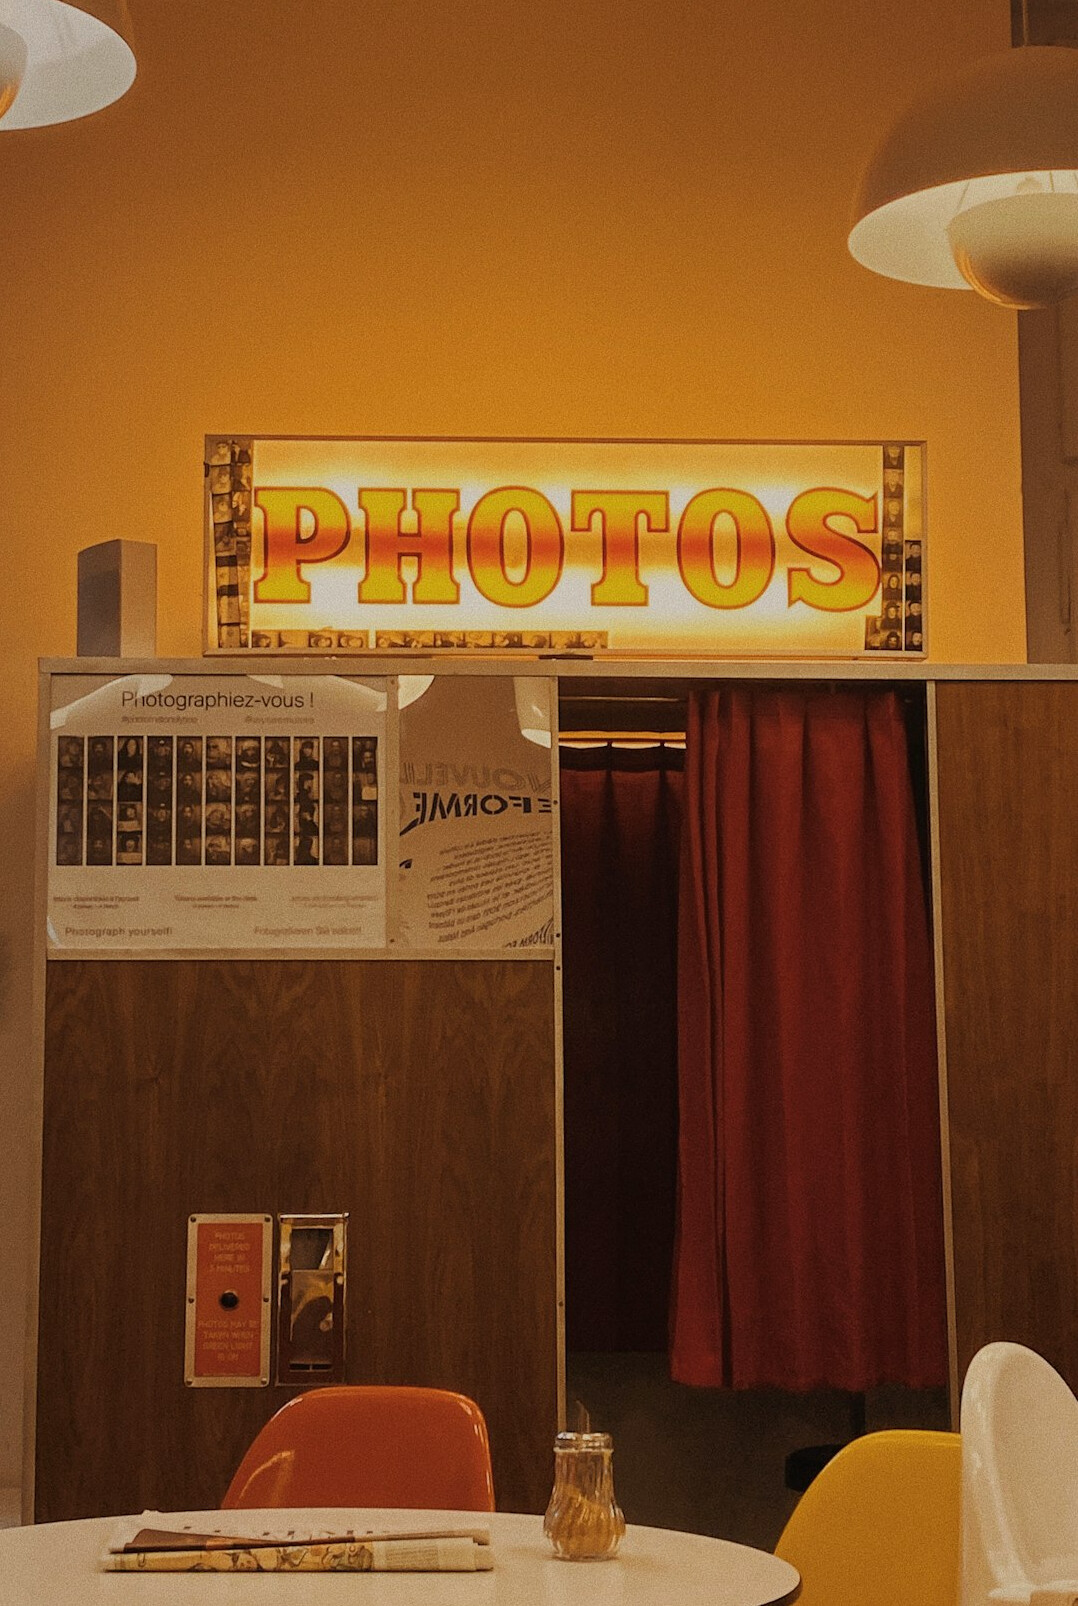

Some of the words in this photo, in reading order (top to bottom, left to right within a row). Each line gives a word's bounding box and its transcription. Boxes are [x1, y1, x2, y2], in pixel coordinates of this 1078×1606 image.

[253, 485, 881, 612] PHOTOS
[122, 690, 305, 711] Photographiez-vous
[65, 926, 125, 938] Photograph
